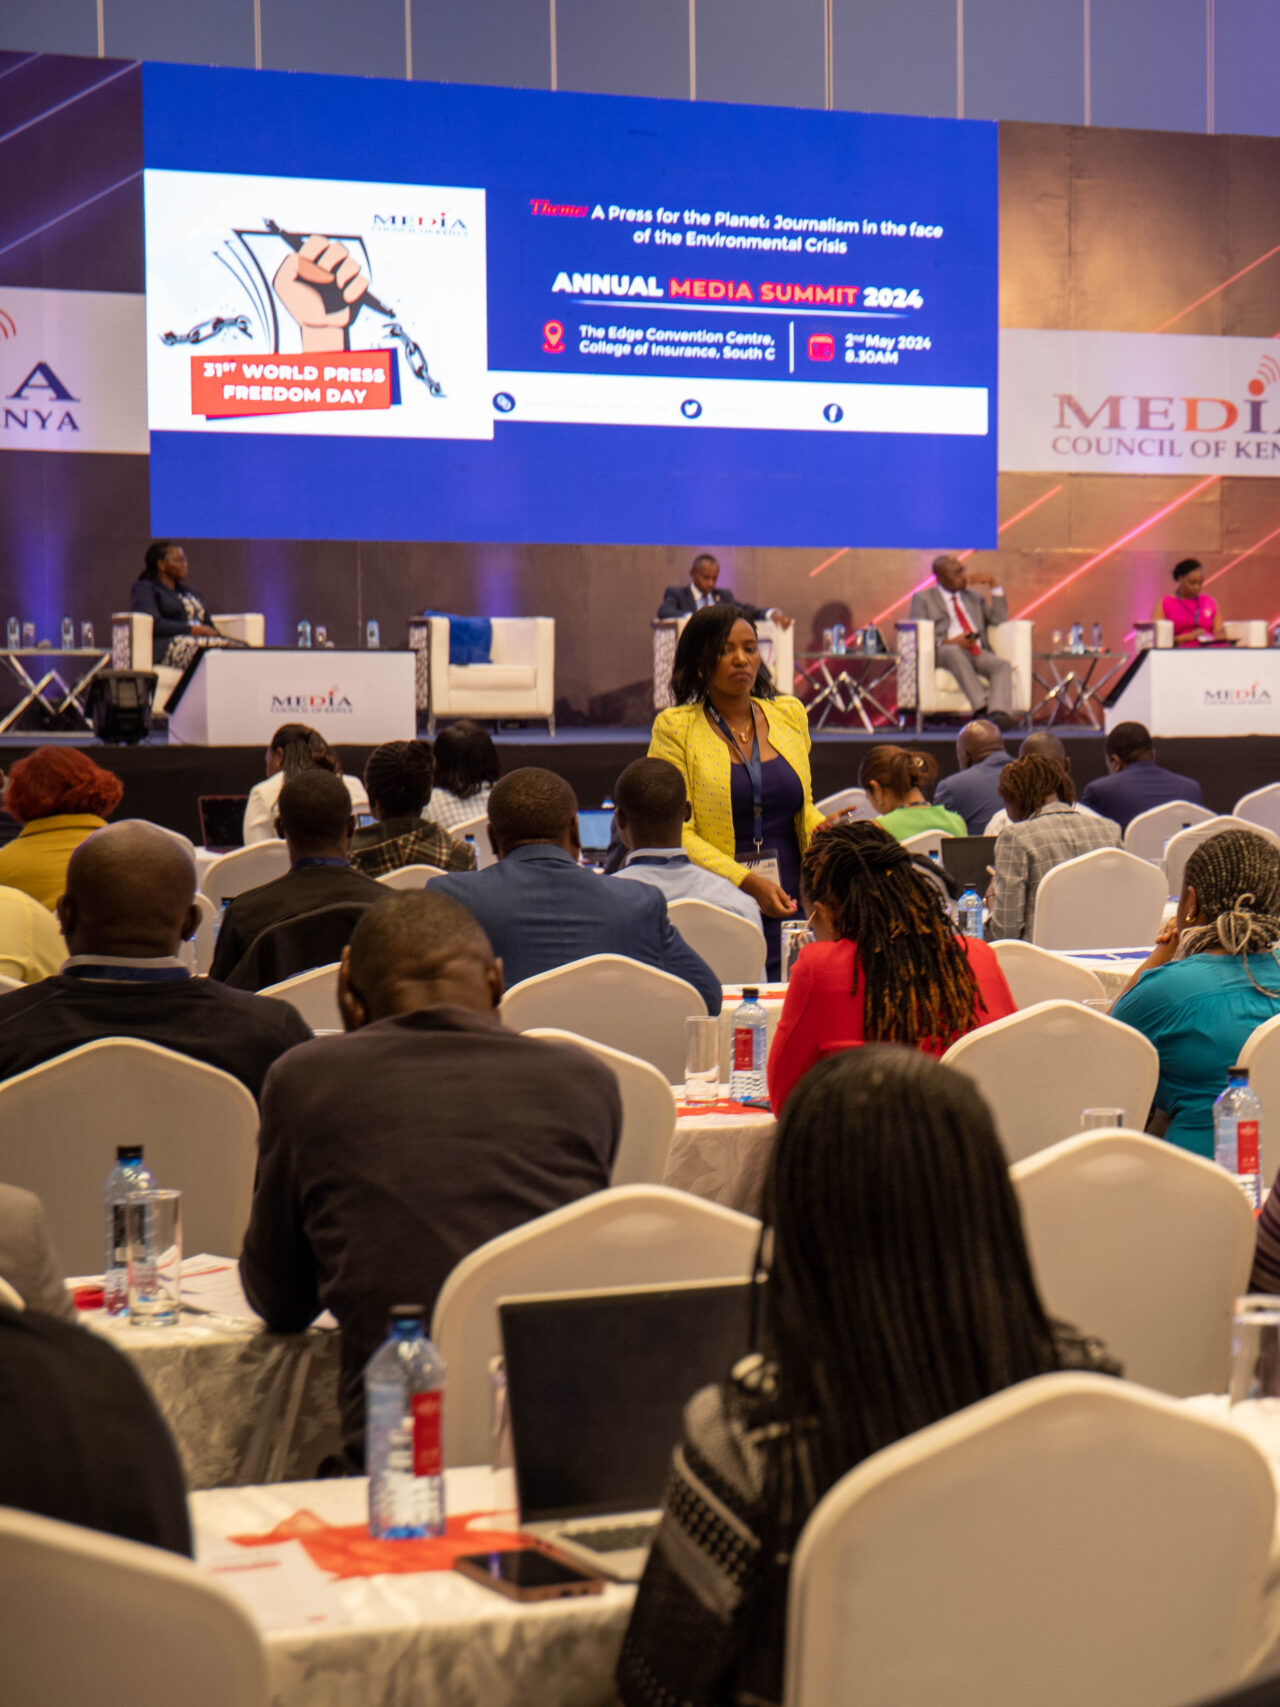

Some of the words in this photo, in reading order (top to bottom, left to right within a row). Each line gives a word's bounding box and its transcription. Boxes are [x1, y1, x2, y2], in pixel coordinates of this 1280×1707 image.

[591, 204, 605, 220] A
[608, 205, 653, 223] Press
[656, 207, 679, 225] for
[683, 209, 710, 227] the
[773, 214, 859, 234] Journalism
[862, 219, 878, 235] in
[881, 220, 906, 237] the
[910, 221, 943, 239] face
[633, 228, 651, 244] of
[654, 230, 682, 246] the
[686, 231, 803, 252] Environmental
[805, 237, 848, 254] Crisis
[551, 272, 664, 298] ANNUAL
[669, 278, 754, 302] MEDIA
[760, 281, 860, 306] SUMMIT
[863, 287, 925, 309] 2024
[579, 324, 605, 339] The
[607, 325, 643, 342] Edge
[645, 327, 724, 344] Convention
[725, 330, 775, 346] Centre,
[865, 333, 896, 351] May
[897, 334, 932, 350] 2024
[579, 340, 631, 357] College
[634, 341, 649, 356] of
[651, 343, 720, 360] Insurance,
[722, 345, 762, 361] South
[764, 346, 775, 361] C
[242, 364, 319, 381] WORLD
[323, 366, 386, 383] PRESS
[223, 385, 320, 402] FREEDOM
[326, 388, 367, 404] DAY
[1052, 436, 1182, 458] COUNCIL
[1190, 440, 1225, 459] OF
